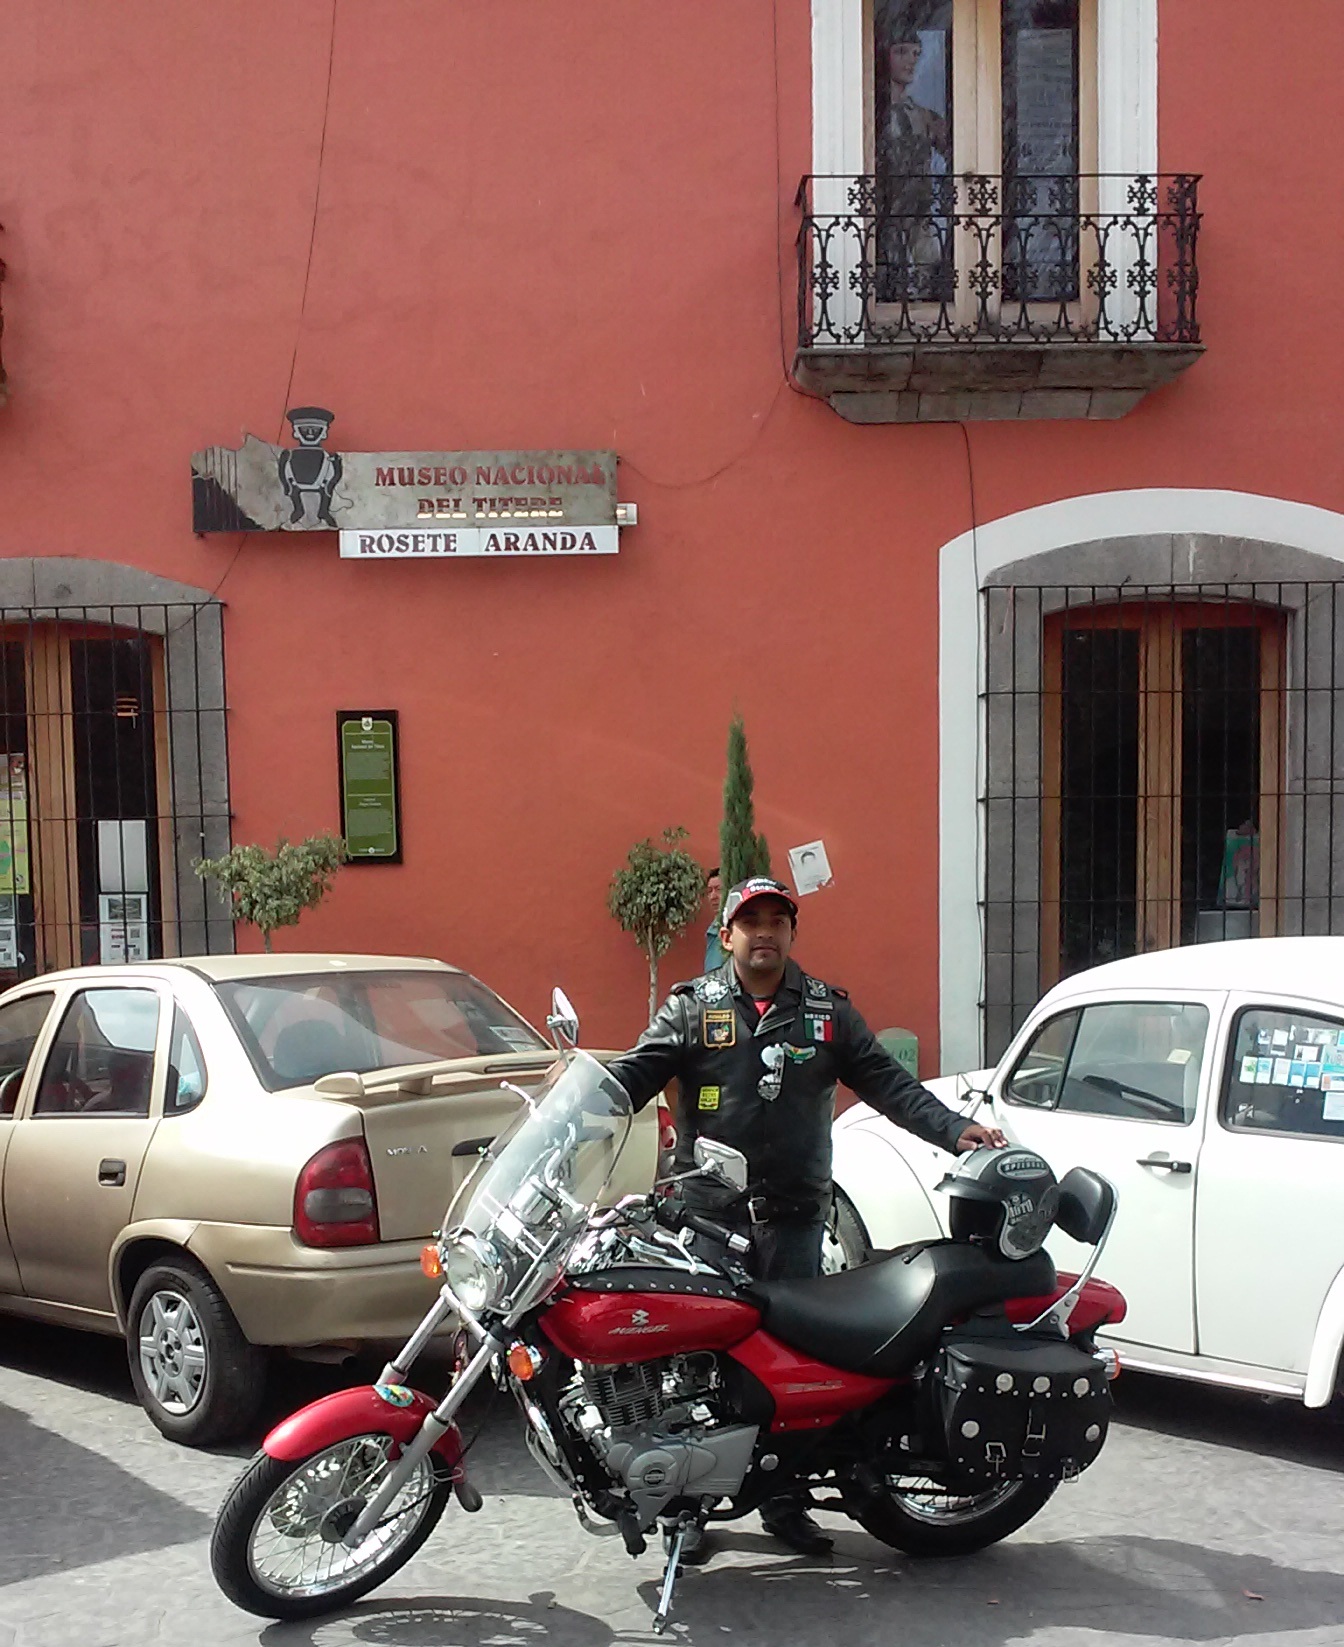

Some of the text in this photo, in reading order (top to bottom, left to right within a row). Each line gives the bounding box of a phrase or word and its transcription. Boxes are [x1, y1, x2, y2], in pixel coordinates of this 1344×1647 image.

[374, 463, 606, 487] MUSEO NACIONAL
[416, 497, 564, 519] DEL TITERE
[358, 531, 598, 554] ROSETE ARANDA
